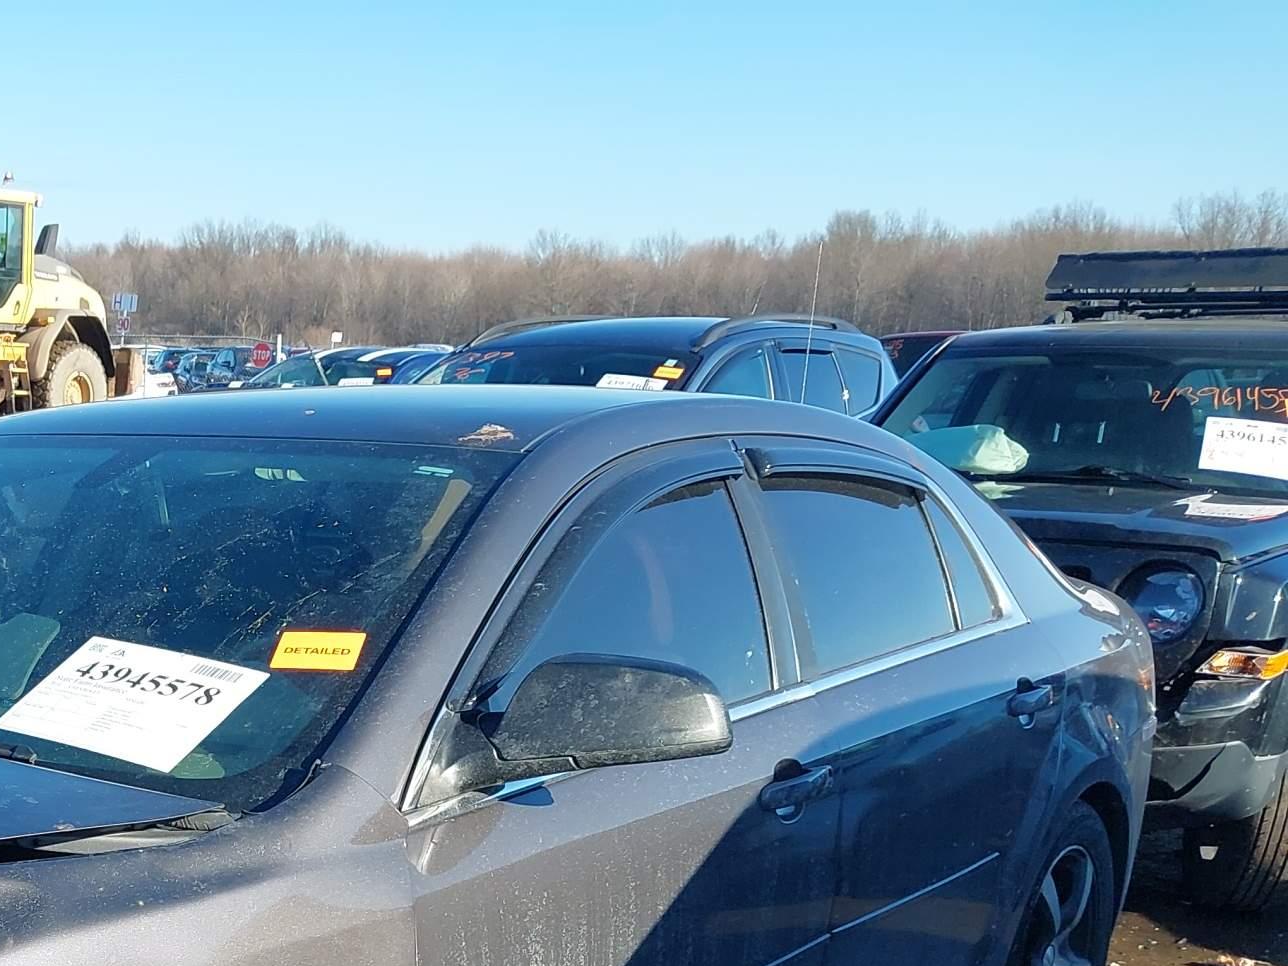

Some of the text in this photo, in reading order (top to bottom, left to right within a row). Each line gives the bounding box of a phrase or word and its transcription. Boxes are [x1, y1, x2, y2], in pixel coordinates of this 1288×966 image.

[253, 349, 271, 360] STOP
[283, 645, 352, 656] DETAILED
[76, 661, 222, 706] 43945578
